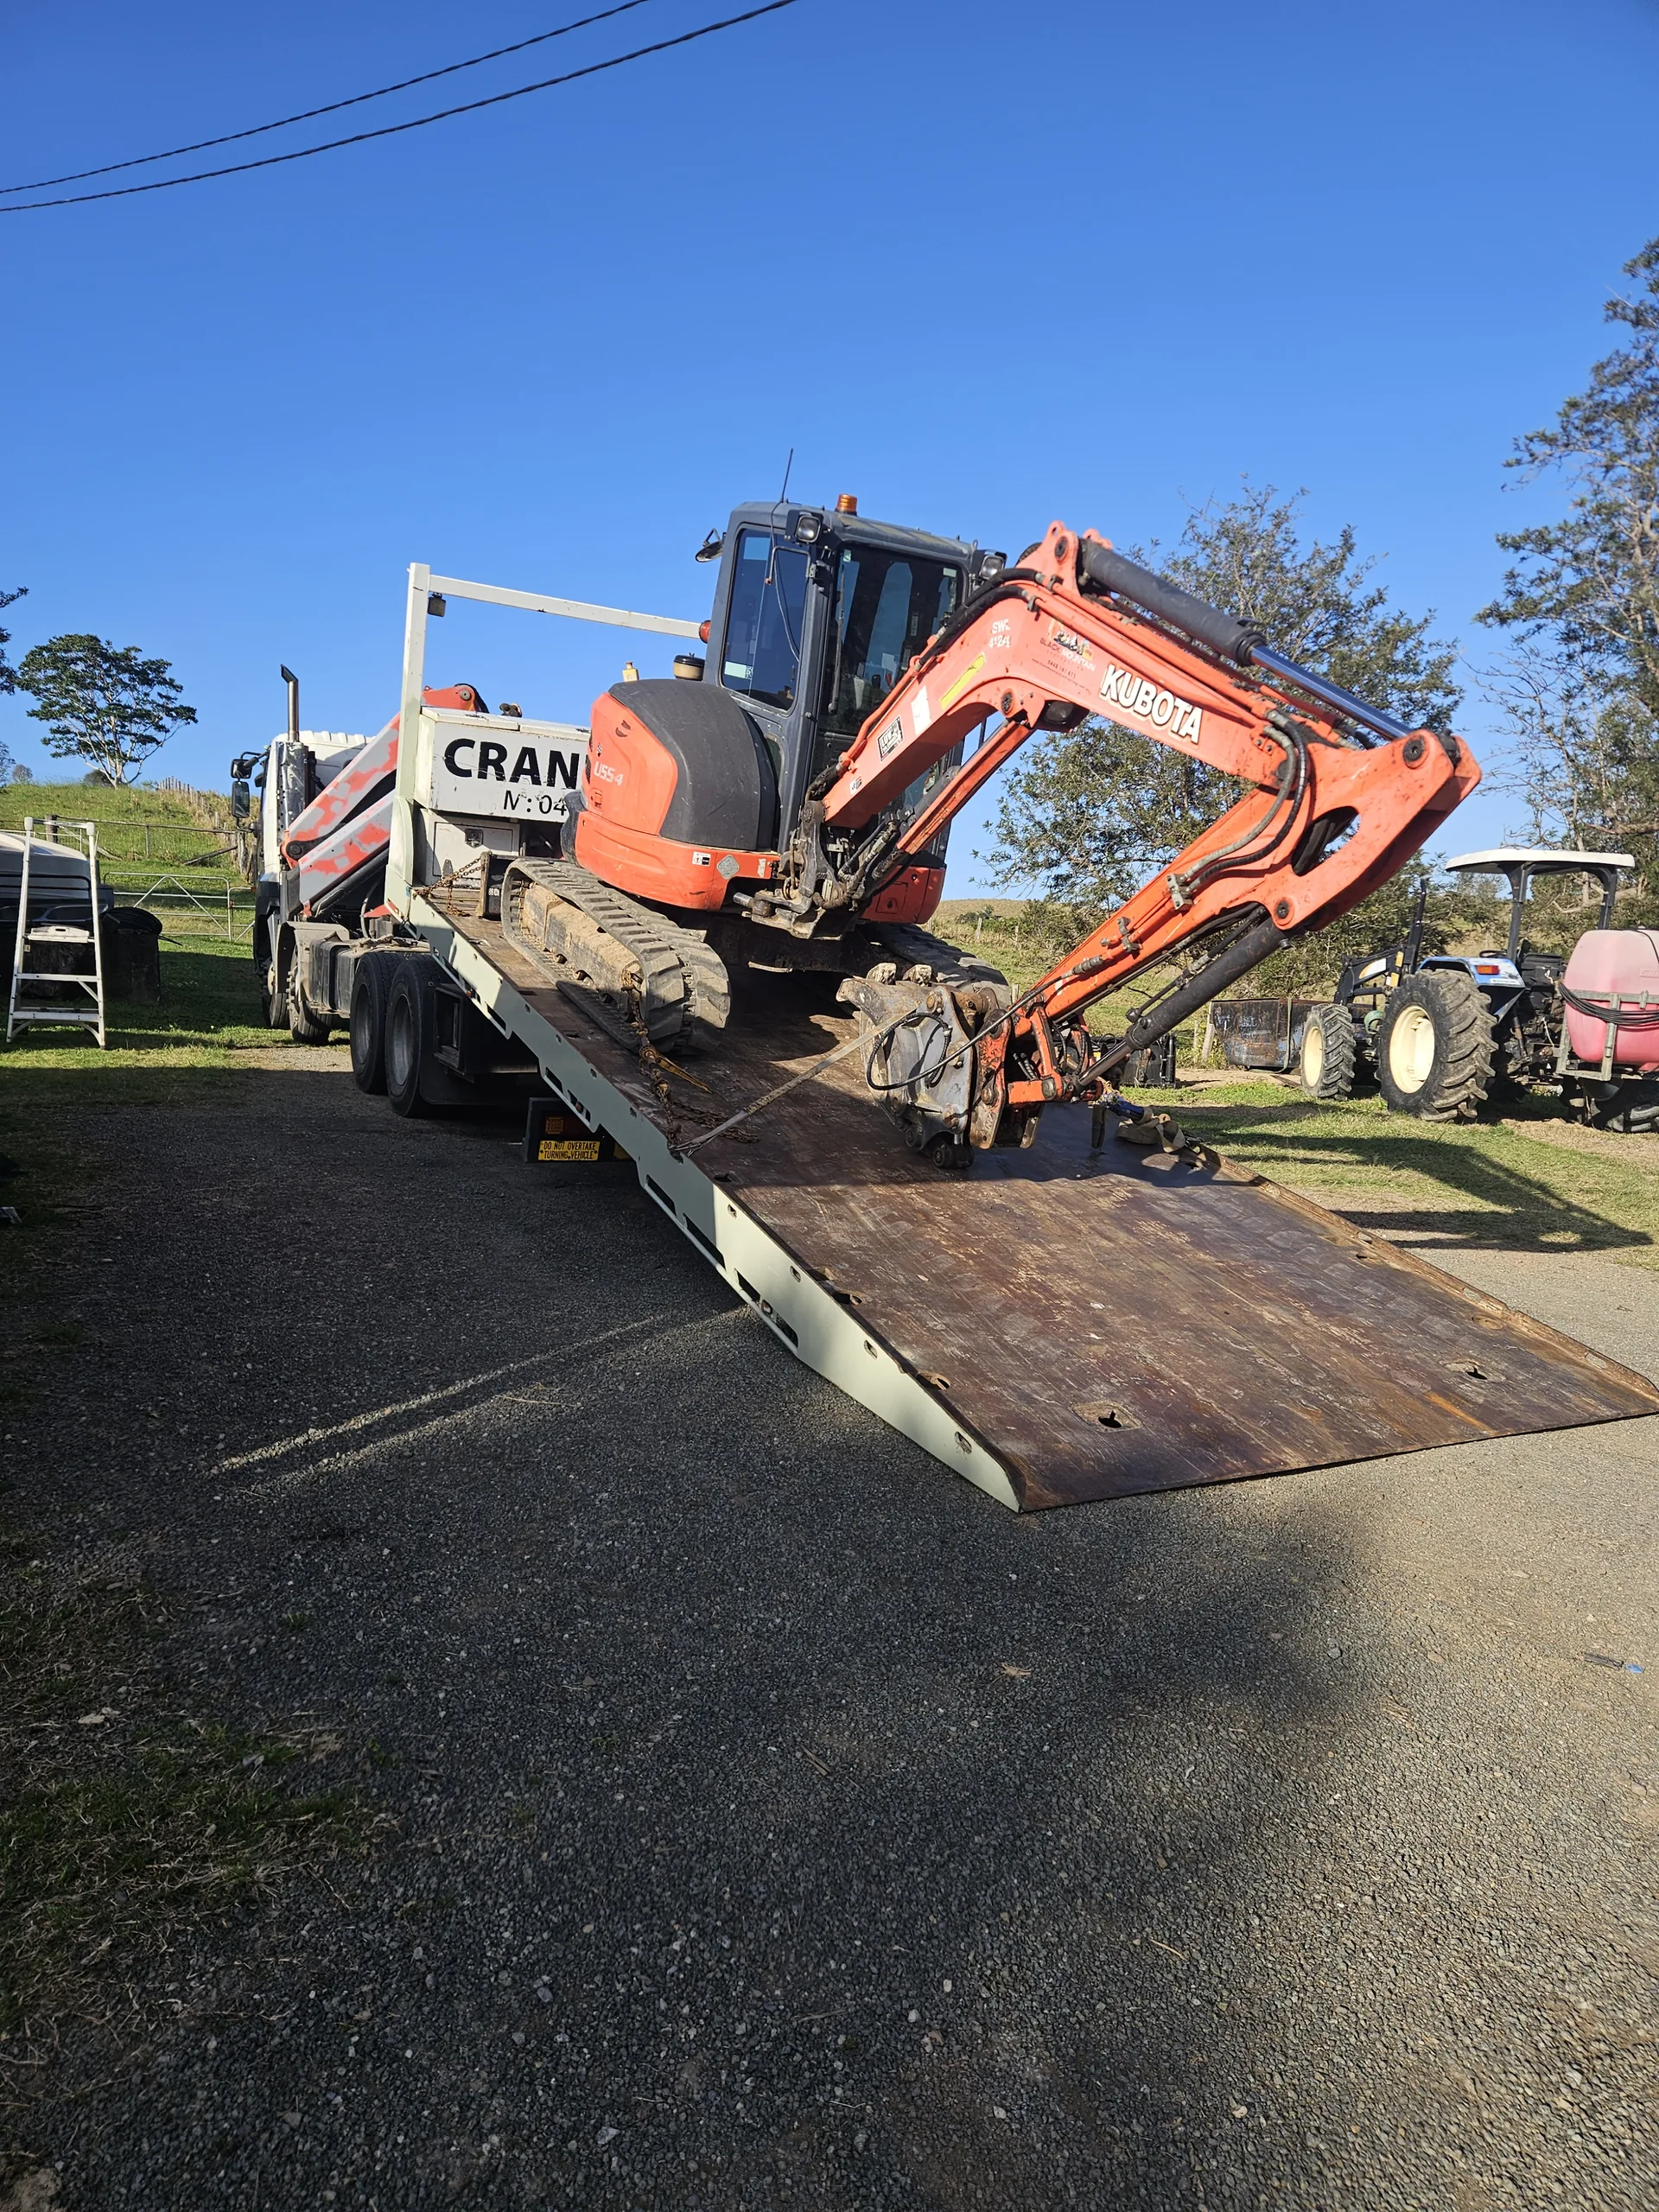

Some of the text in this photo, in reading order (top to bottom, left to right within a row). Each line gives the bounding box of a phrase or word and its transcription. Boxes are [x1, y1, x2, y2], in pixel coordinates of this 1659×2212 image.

[1100, 664, 1204, 746] KUBOTA
[444, 738, 590, 790] CRAN
[543, 1141, 596, 1150] DO NOT OVERTAKE
[544, 1150, 594, 1159] TURNING VEHICLE
